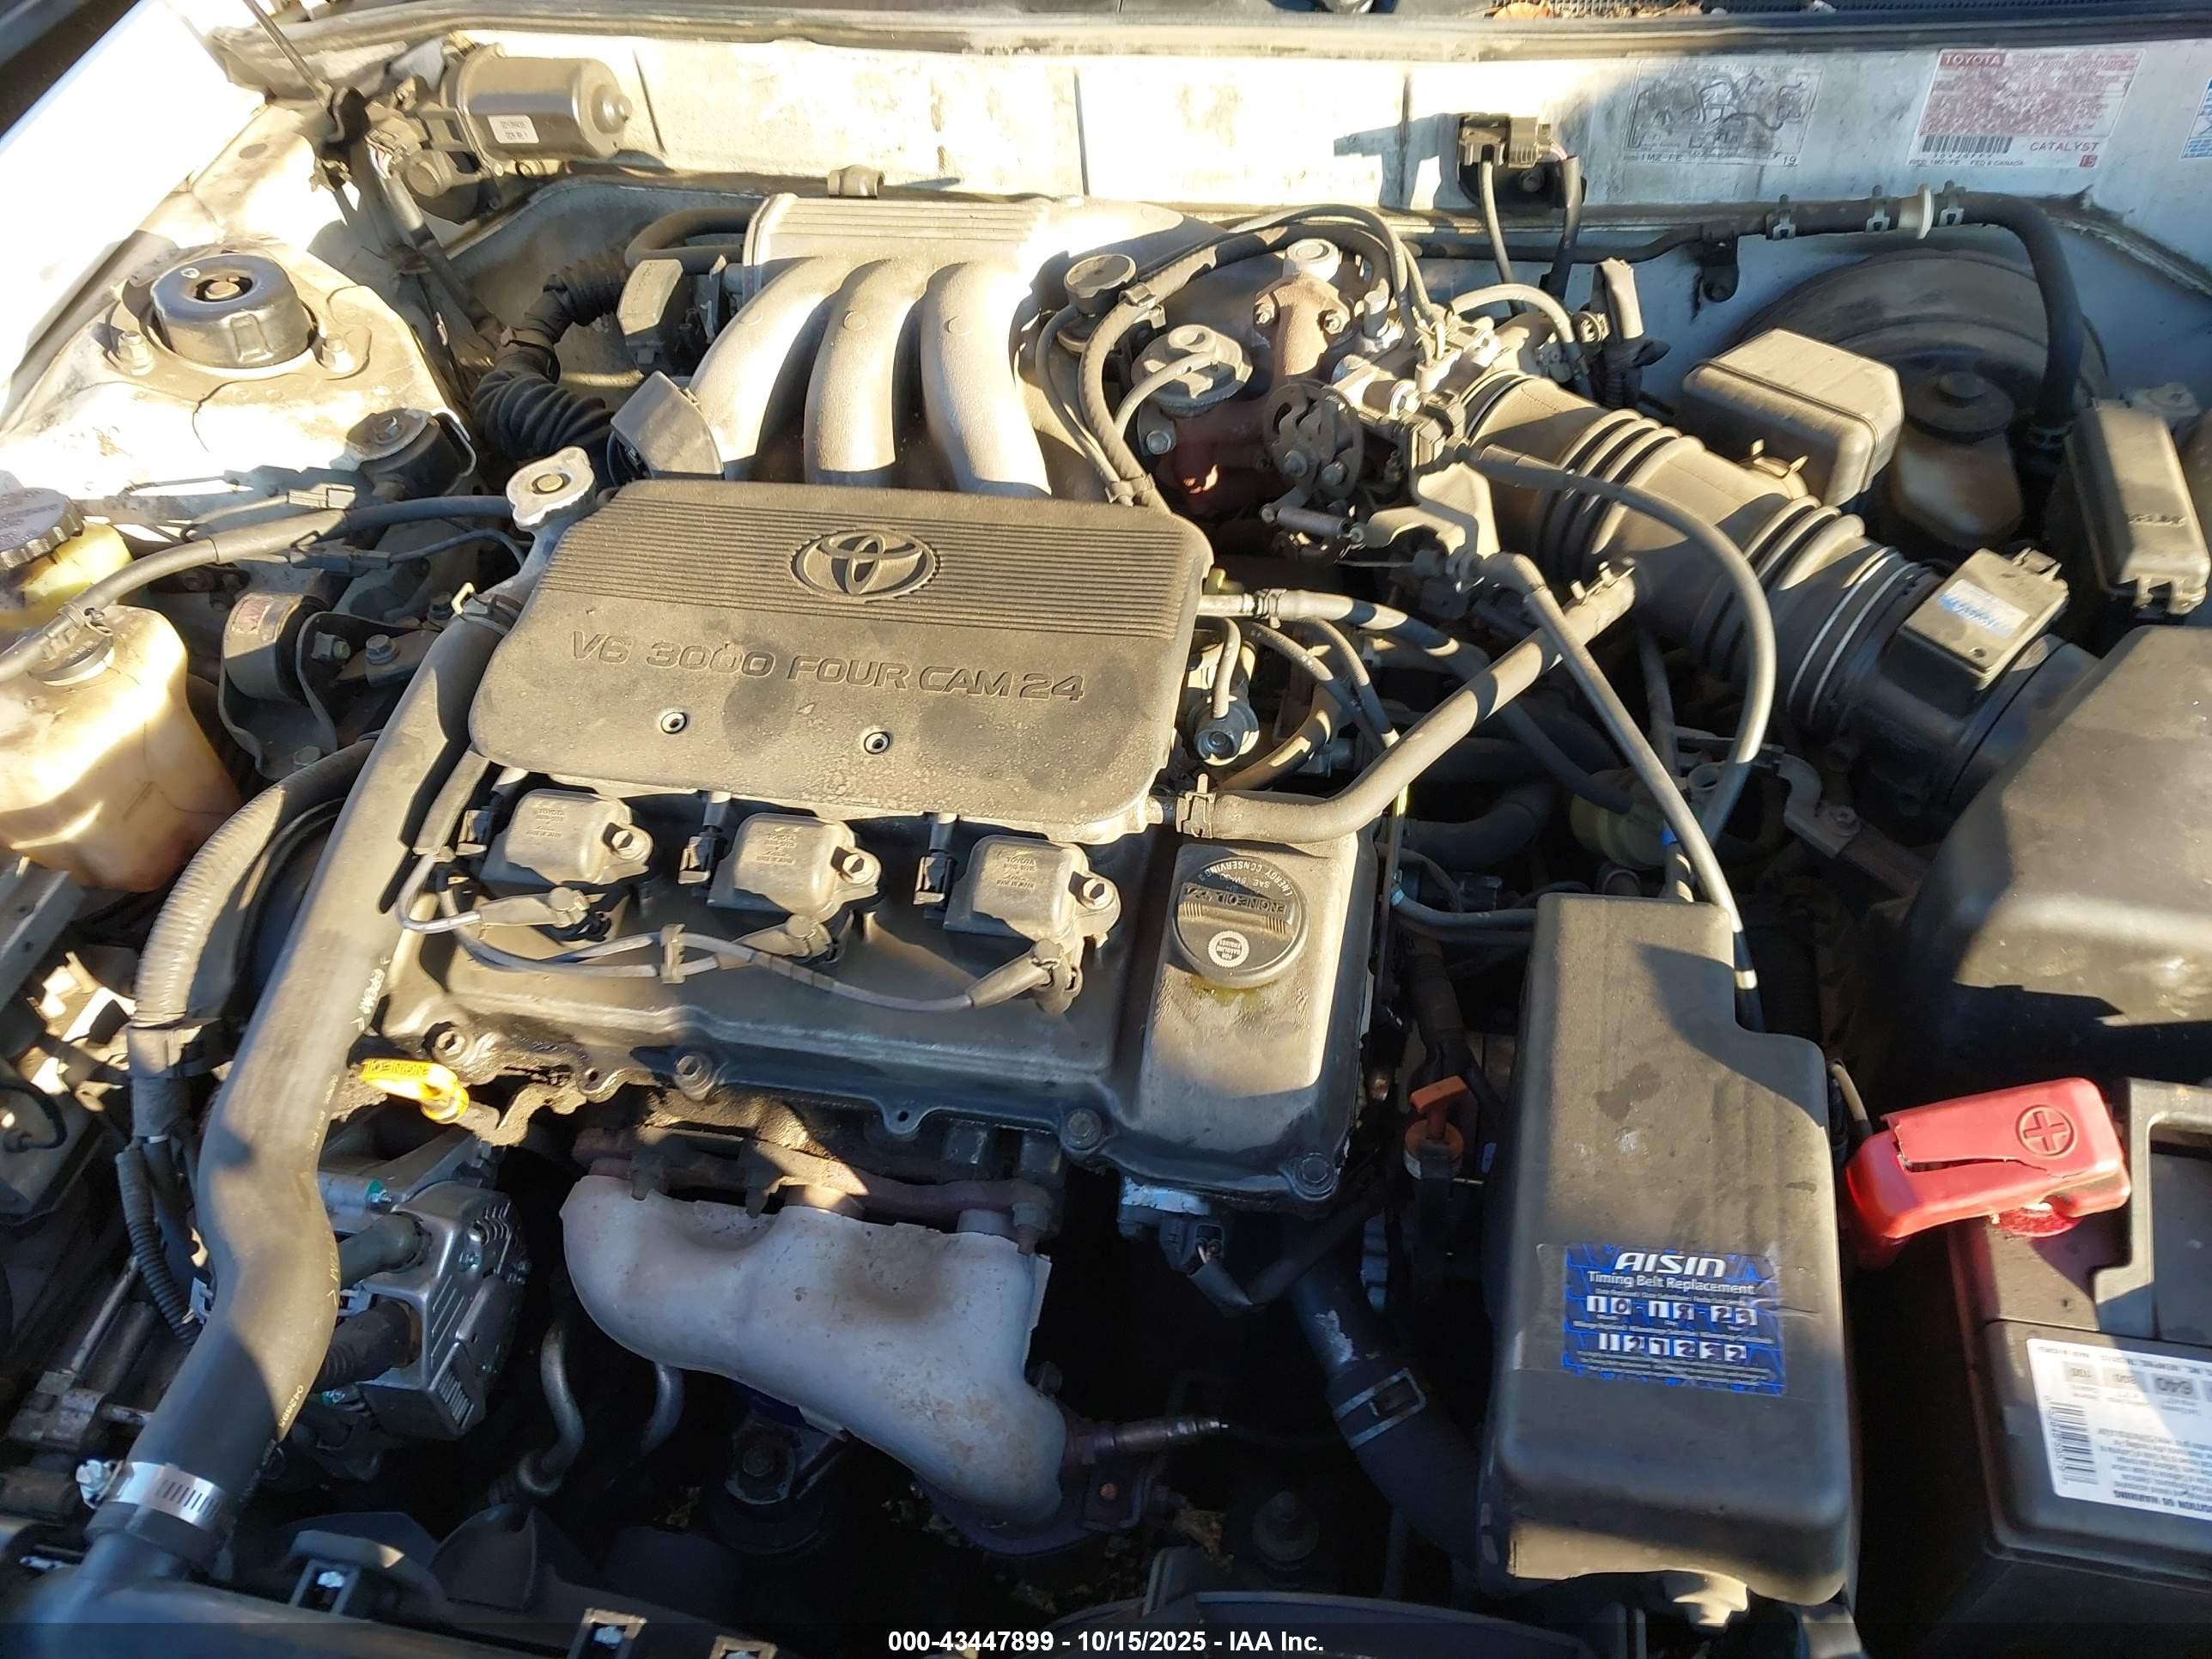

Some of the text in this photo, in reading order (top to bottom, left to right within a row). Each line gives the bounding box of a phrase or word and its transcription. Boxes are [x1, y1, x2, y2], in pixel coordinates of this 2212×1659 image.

[1945, 53, 2002, 67] TOYOTA
[2029, 142, 2100, 152] CATALYST
[1782, 155, 1797, 166] 19
[571, 630, 1086, 703] V6 3000 FOUR CAM 24
[1204, 860, 1263, 878] CONSERVING
[1252, 878, 1271, 889] SAE
[1221, 951, 1233, 960] FOR
[1614, 1252, 1727, 1278] AISIN
[1587, 1270, 1756, 1295] Timing Belt Replacement
